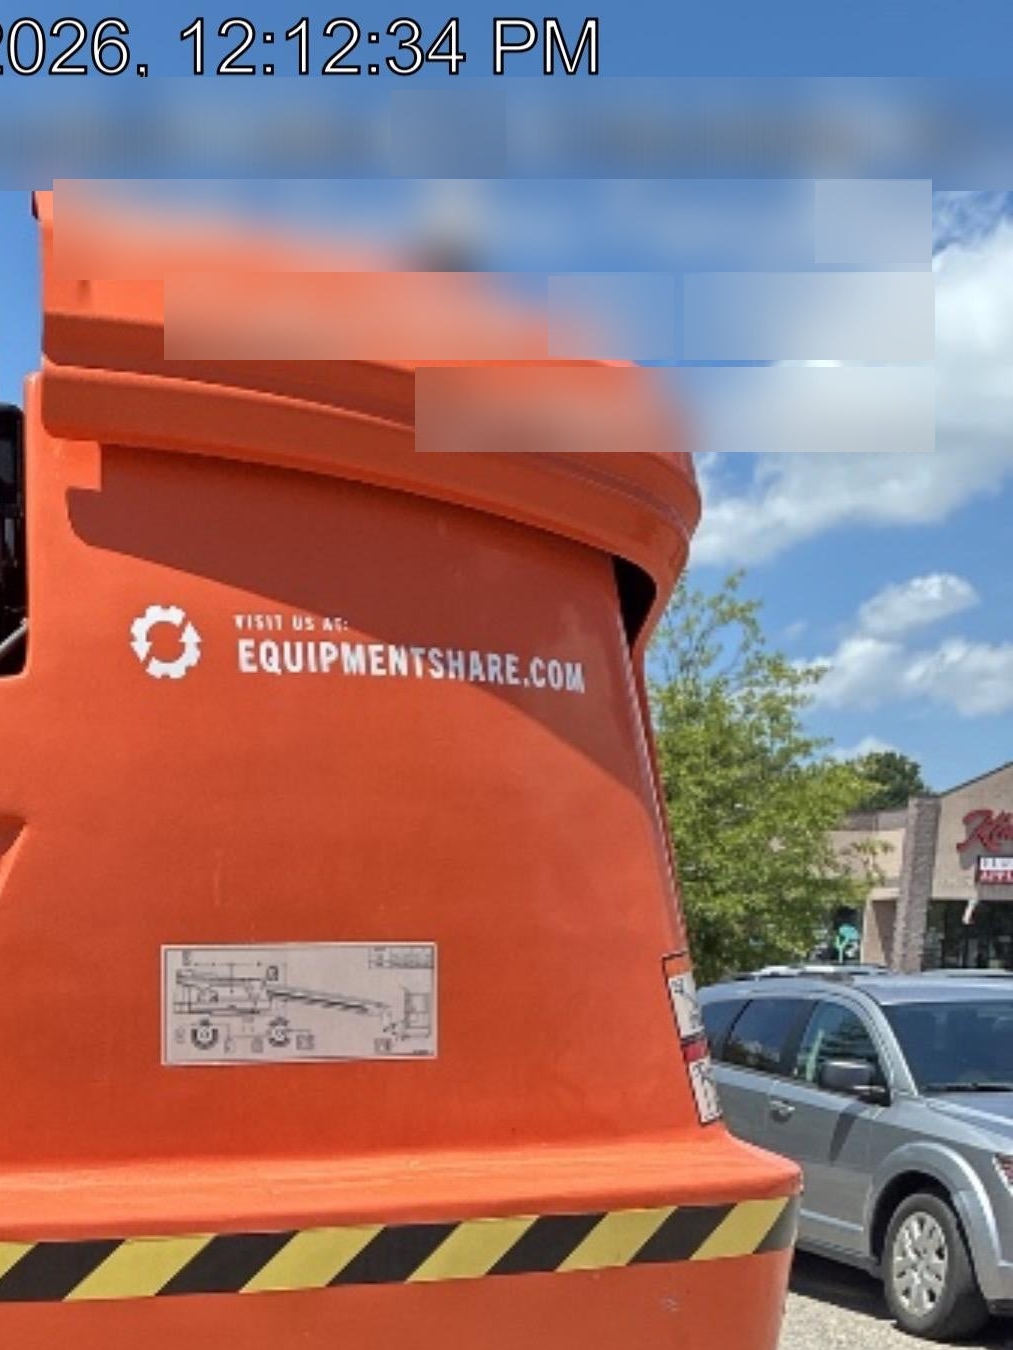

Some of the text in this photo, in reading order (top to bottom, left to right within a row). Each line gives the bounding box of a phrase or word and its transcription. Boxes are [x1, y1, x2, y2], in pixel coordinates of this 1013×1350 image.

[234, 614, 282, 631] VISIT
[292, 615, 315, 631] US
[237, 638, 586, 694] EQUIPMENTSHARE.COM
